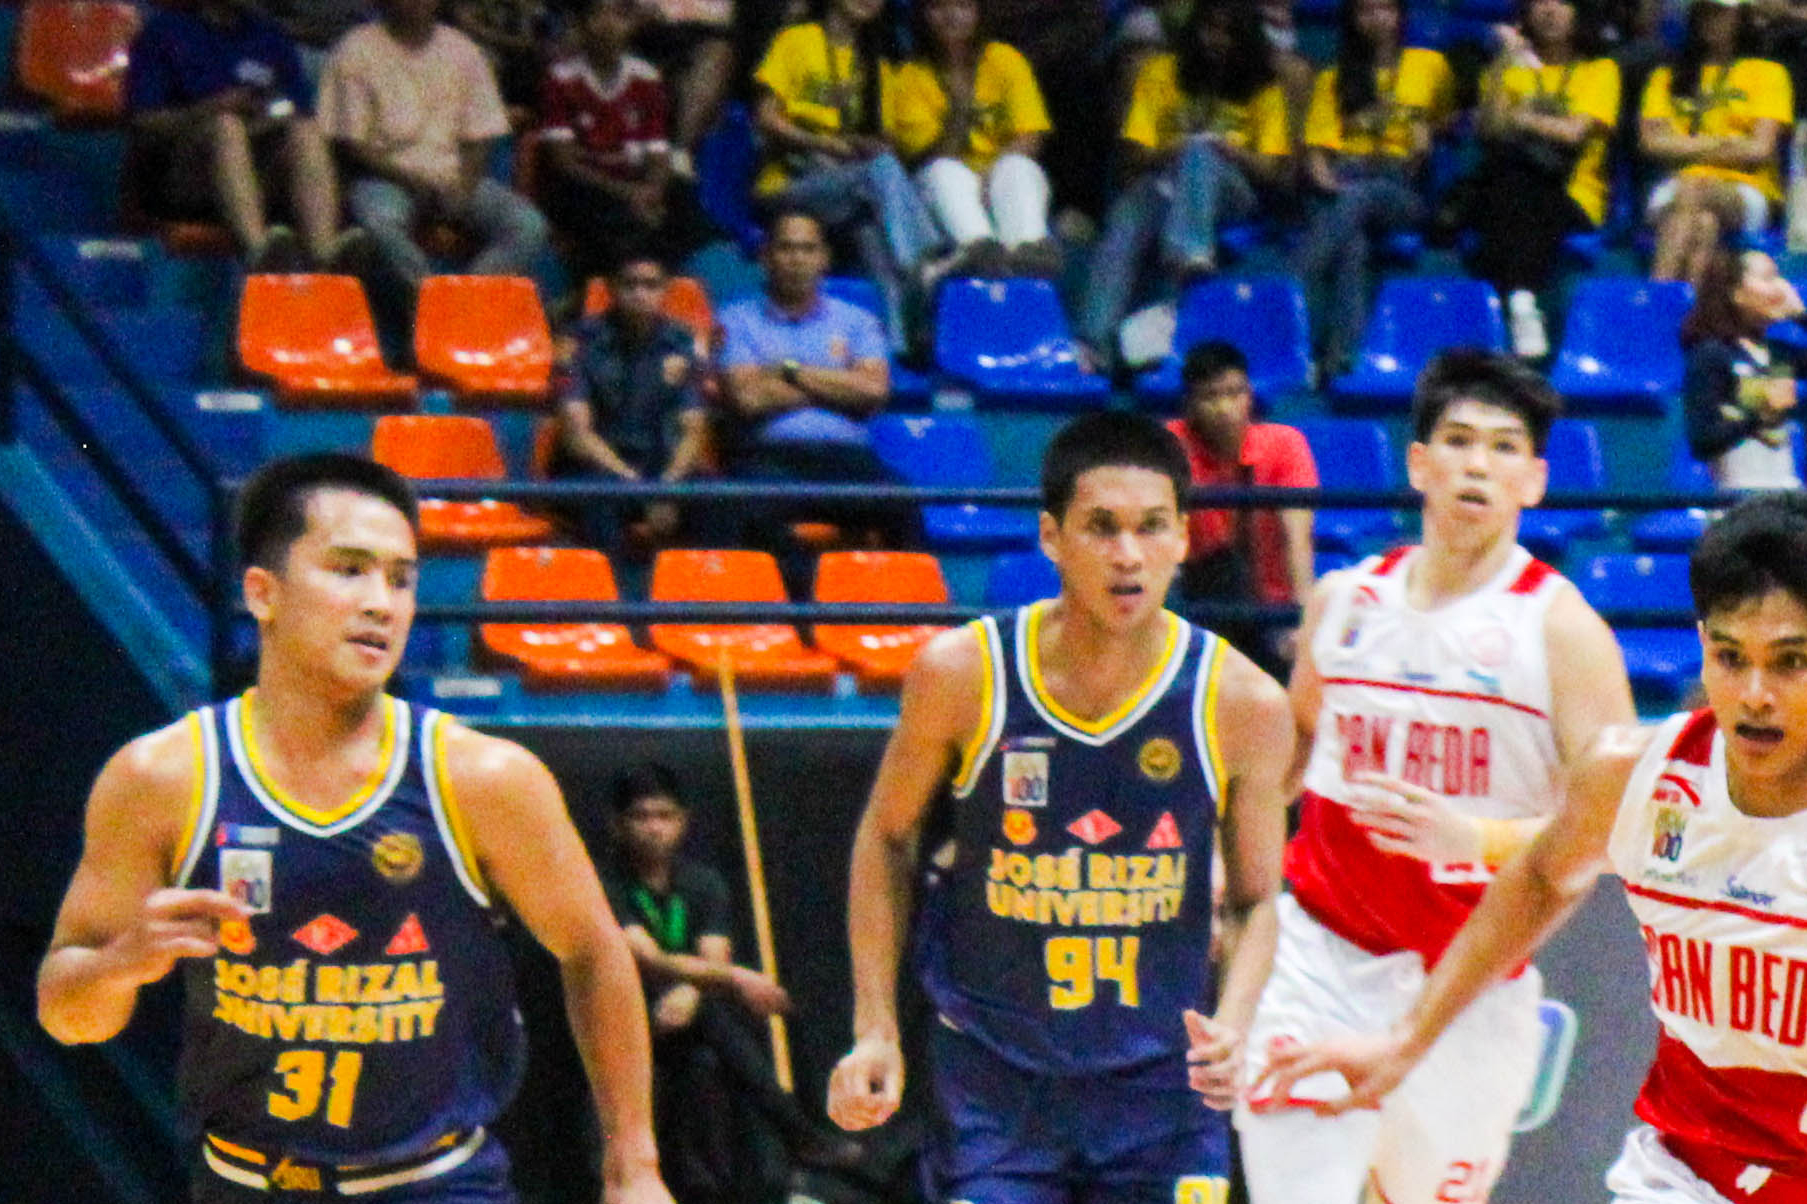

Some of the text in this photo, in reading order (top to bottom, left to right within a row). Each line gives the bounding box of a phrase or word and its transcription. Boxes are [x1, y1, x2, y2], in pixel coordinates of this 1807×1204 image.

[985, 879, 1187, 927] UNIVERSITY
[1043, 936, 1140, 1011] 94
[267, 1050, 363, 1129] 31
